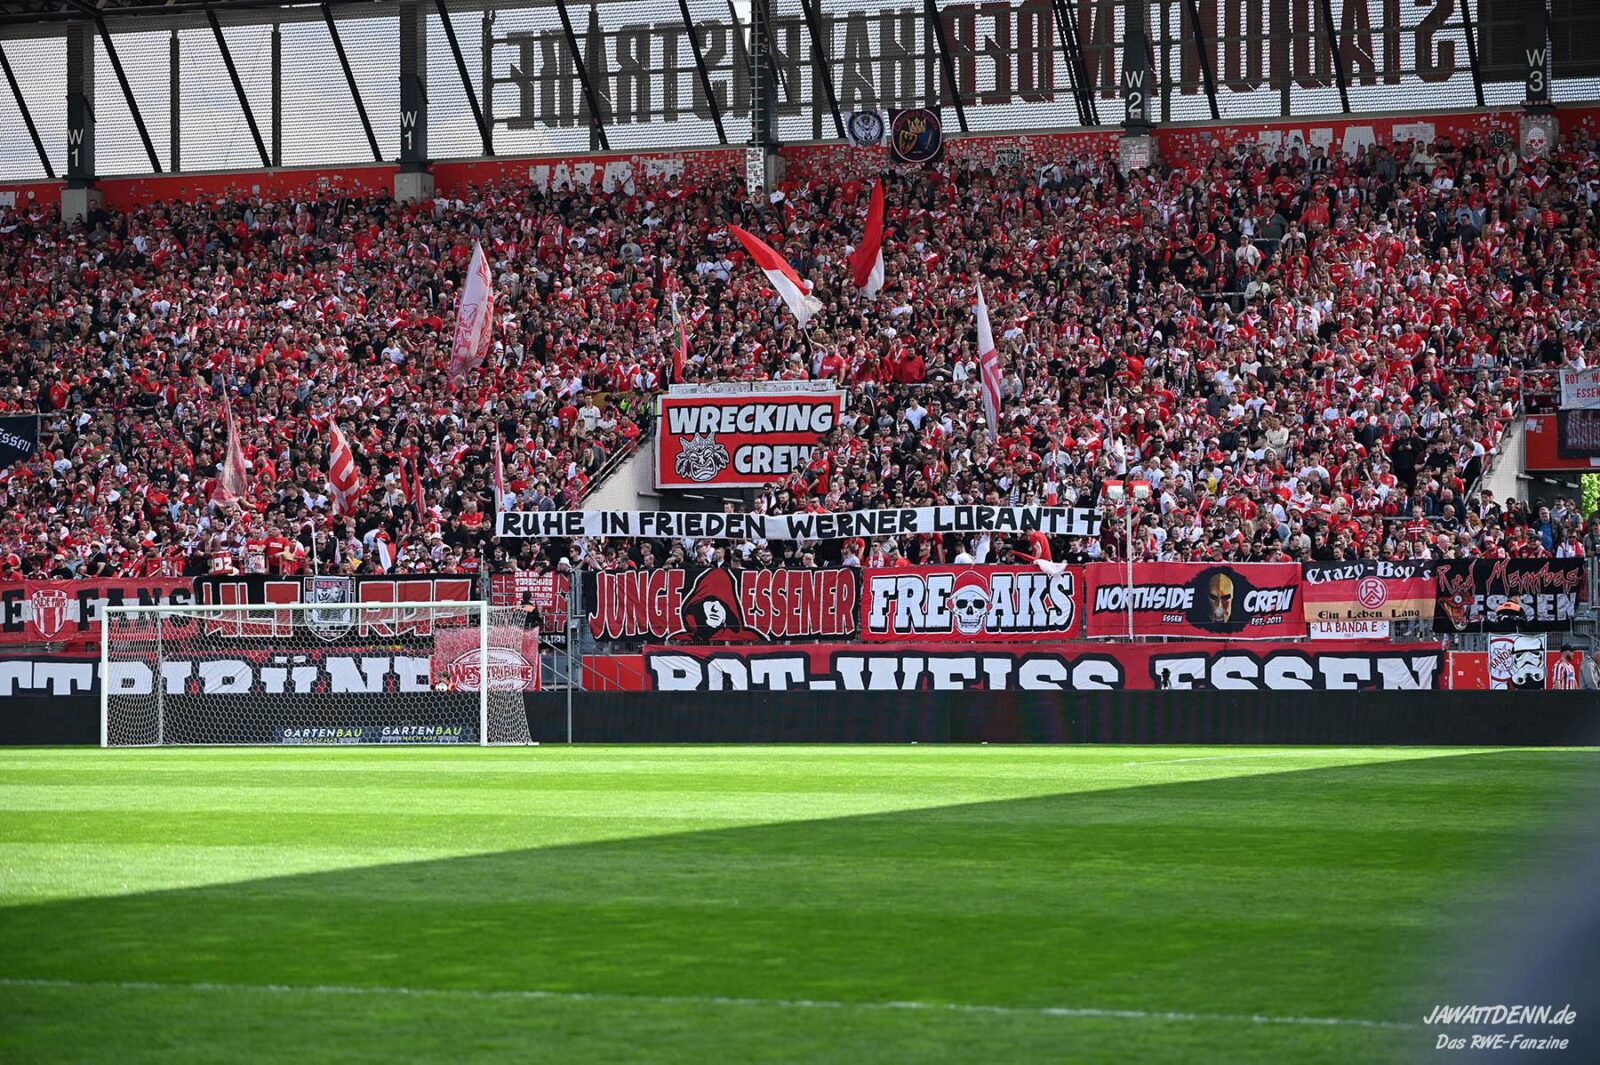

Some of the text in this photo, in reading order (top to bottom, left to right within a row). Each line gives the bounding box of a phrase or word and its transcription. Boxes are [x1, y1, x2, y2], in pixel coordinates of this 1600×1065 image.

[1526, 49, 1546, 67] W
[1125, 70, 1144, 88] W
[1529, 70, 1543, 92] 3
[1128, 91, 1142, 112] 2
[400, 111, 418, 128] W
[67, 129, 84, 145] W
[405, 132, 413, 149] 1
[71, 150, 79, 167] 1
[1564, 374, 1579, 385] ROT
[668, 404, 833, 434] WRECKING
[734, 445, 818, 474] CREW
[502, 511, 585, 536] RUHE
[601, 511, 630, 535] IN
[639, 511, 766, 538] FRIEDEN
[785, 509, 918, 539] WERNER
[1436, 552, 1579, 596] Red Mambas
[588, 568, 687, 639] JUNGE
[740, 568, 855, 638] ESSENER
[869, 571, 1075, 634] FREAKS
[1094, 586, 1296, 613] NORTHSIDE CREW
[1162, 614, 1184, 623] ESSEN
[1266, 616, 1282, 625] 2011
[1318, 610, 1339, 620] Ein
[1347, 609, 1383, 619] Leben
[1320, 621, 1378, 633] LA BANDA E
[1155, 654, 1438, 691] ESSEN
[284, 728, 362, 738] GARTENBAU
[382, 726, 462, 736] GARTENBAU
